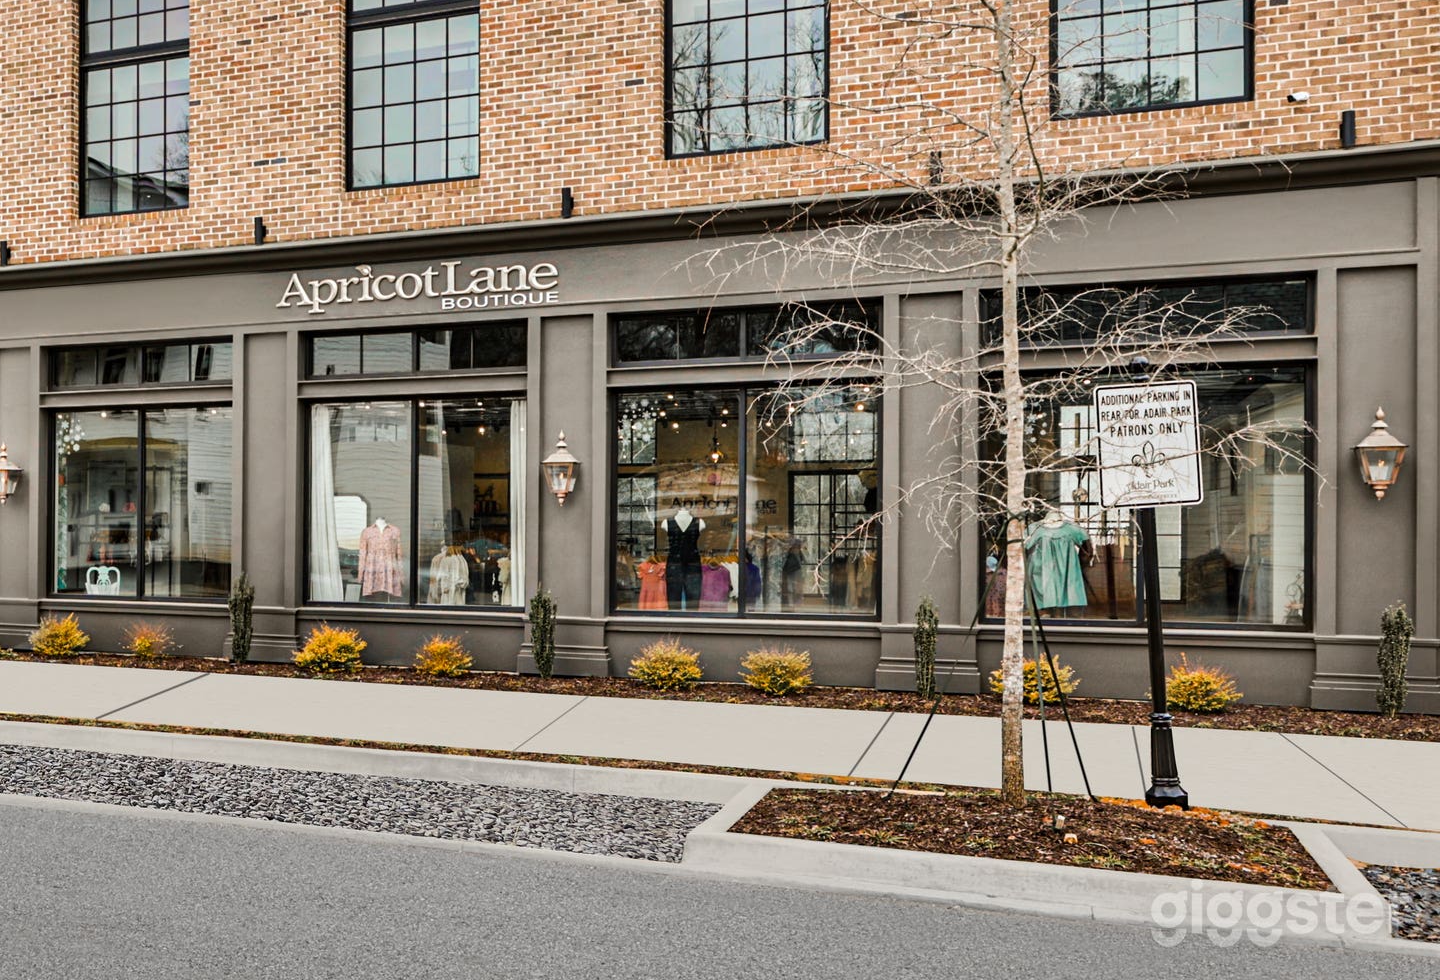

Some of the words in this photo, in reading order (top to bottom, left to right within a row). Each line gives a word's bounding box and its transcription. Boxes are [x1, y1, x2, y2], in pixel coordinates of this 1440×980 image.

[441, 291, 559, 310] BOUTIQUE
[1101, 394, 1143, 406] ADDITIONAL
[1147, 391, 1180, 403] PARKING
[1183, 390, 1191, 400] IN
[1101, 410, 1121, 421] REAR
[1125, 409, 1140, 420] FOR
[1144, 407, 1167, 419] ADAIR
[1171, 406, 1192, 417] PARK
[1111, 424, 1154, 437] PATRONS
[1160, 422, 1184, 434] ONLY
